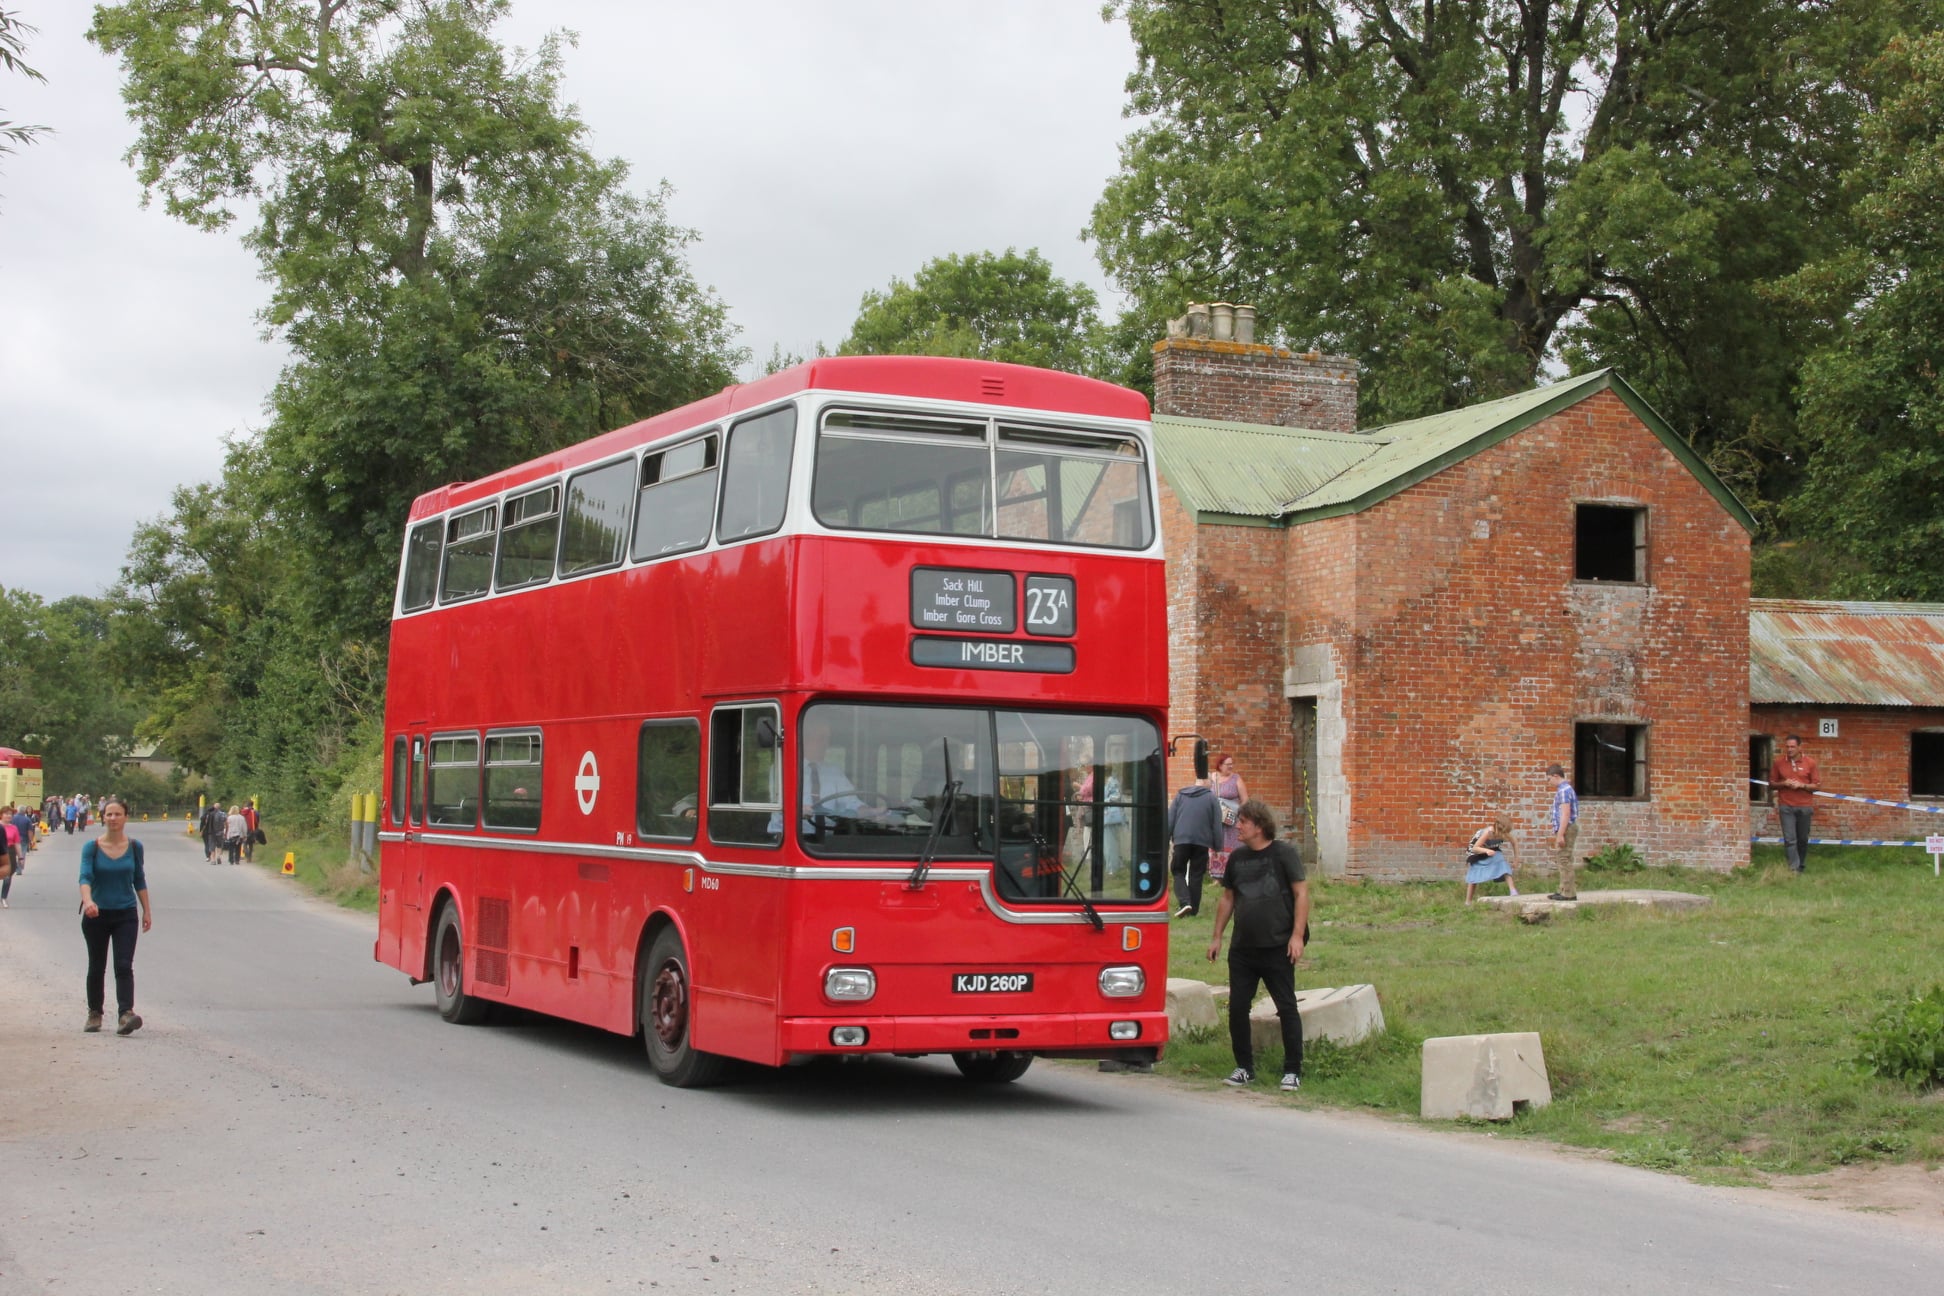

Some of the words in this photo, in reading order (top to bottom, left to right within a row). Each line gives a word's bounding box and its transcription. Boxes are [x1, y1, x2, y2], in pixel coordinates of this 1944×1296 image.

[943, 578, 964, 592] Sack
[967, 580, 983, 592] Hill
[935, 593, 960, 606] Imber
[964, 595, 991, 611] Clump
[923, 608, 948, 622] Imber
[956, 610, 976, 623] Gore
[979, 612, 1002, 625] Cross
[961, 641, 1025, 664] IMBER
[1823, 722, 1835, 733] 81
[701, 876, 720, 890] MD60
[957, 975, 988, 992] KJD
[990, 974, 1028, 992] 260P
